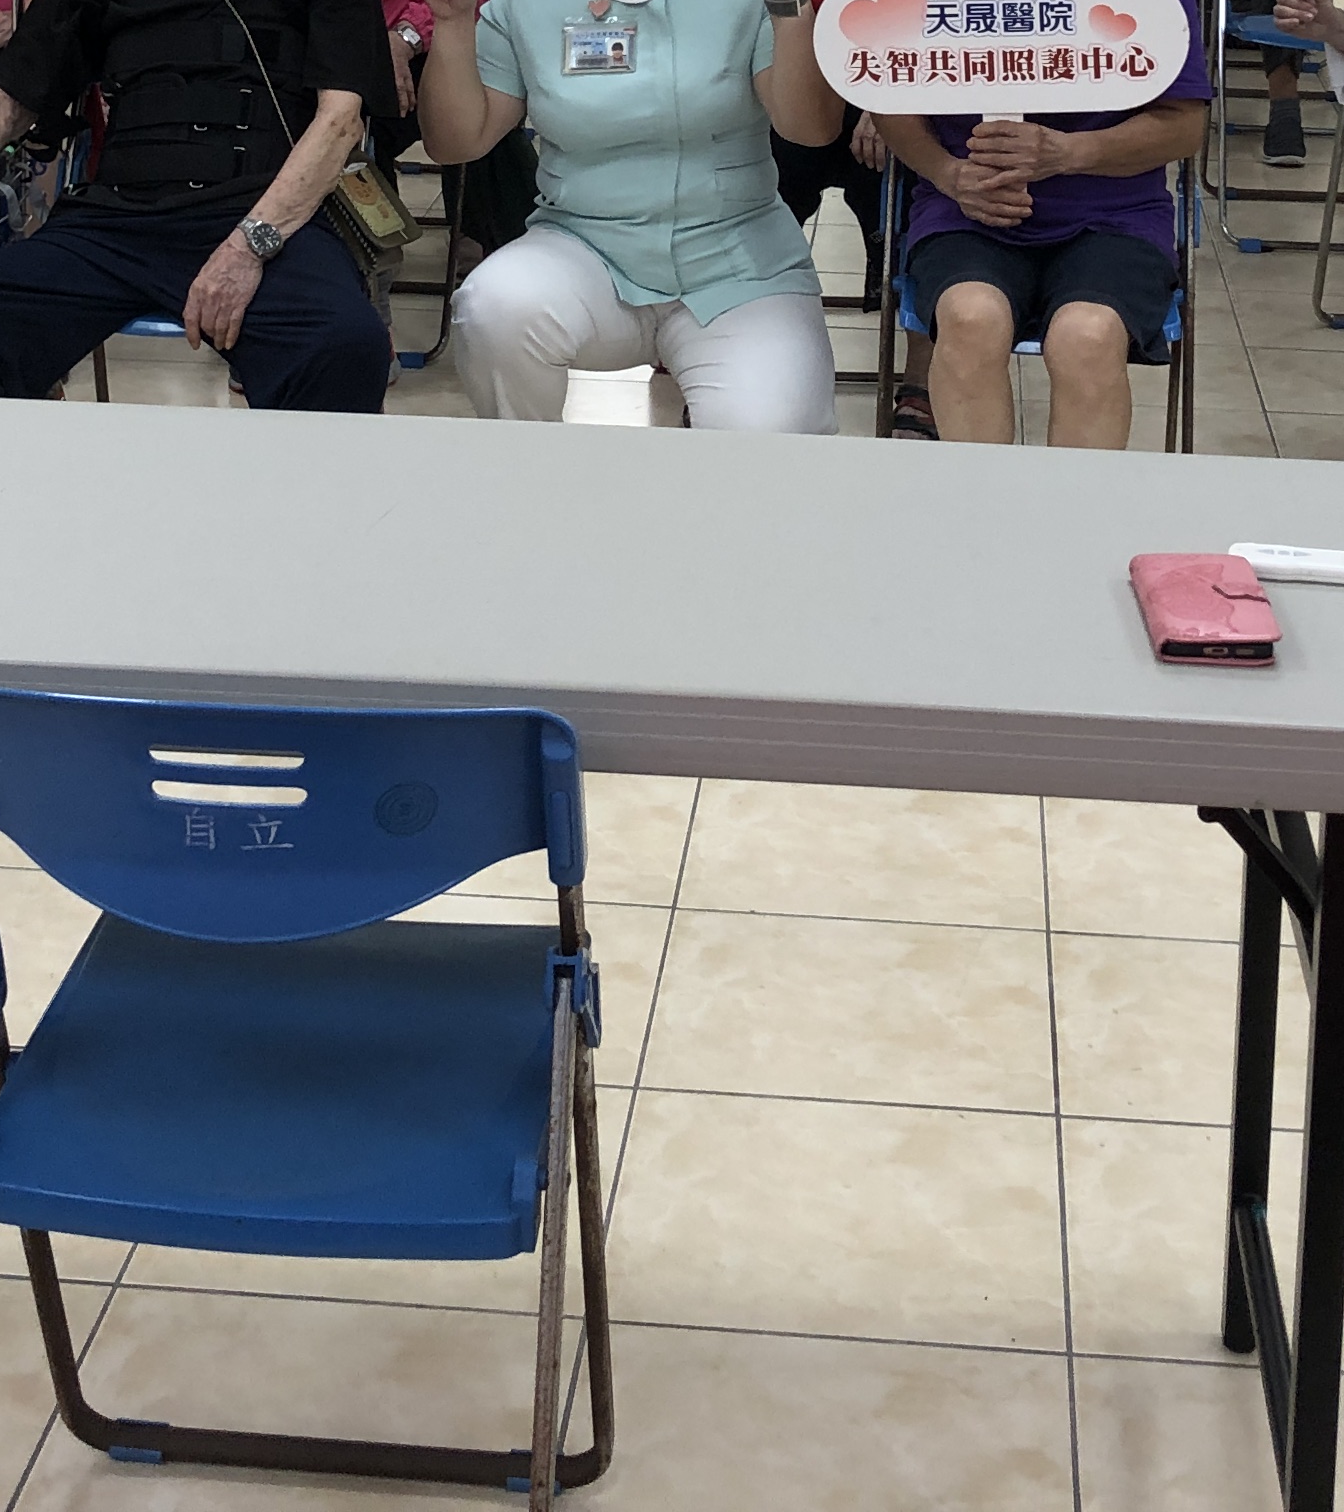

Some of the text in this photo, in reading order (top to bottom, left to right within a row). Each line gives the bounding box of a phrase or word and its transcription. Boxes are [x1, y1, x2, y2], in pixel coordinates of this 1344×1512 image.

[926, 1, 1074, 35] 天晟醫院
[849, 46, 1156, 84] 失智共同照護中心
